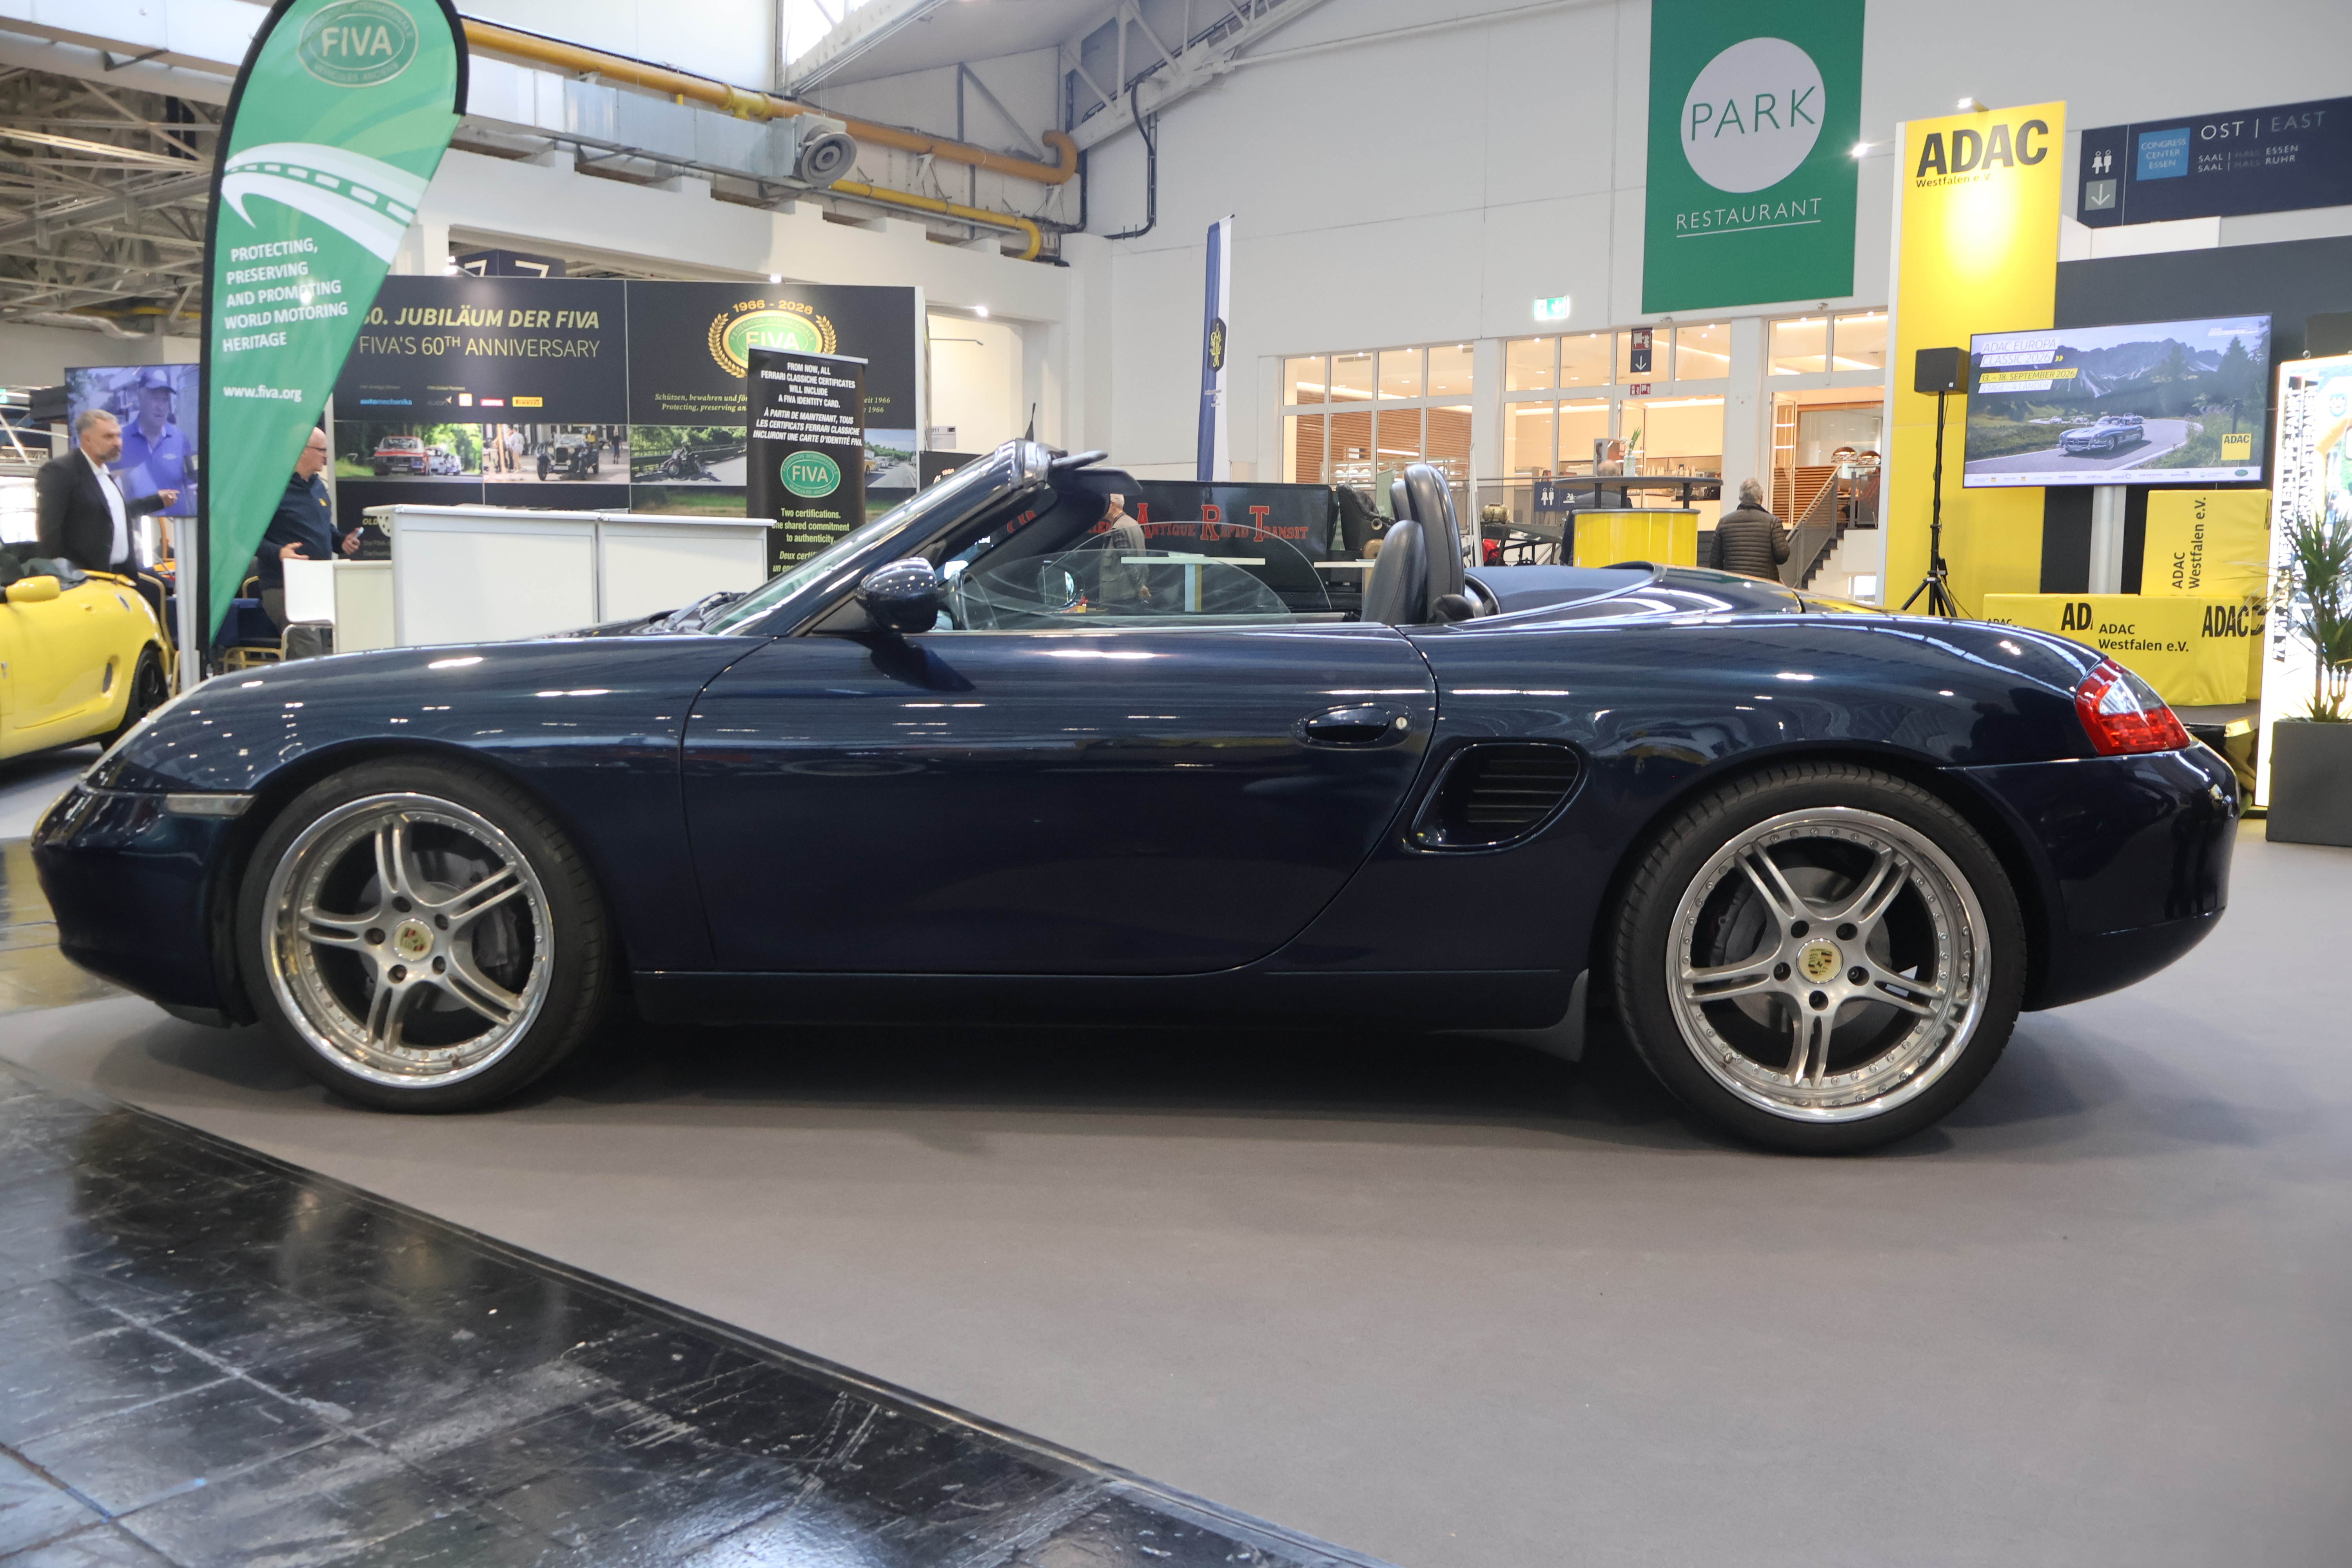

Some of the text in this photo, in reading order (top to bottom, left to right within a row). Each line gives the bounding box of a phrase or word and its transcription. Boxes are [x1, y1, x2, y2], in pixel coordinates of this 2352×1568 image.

[322, 25, 392, 57] FIVA
[1691, 85, 1816, 142] PARK
[2201, 121, 2244, 140] OST
[2271, 111, 2326, 132] EAST
[1916, 119, 2049, 178] ADAC
[2141, 138, 2186, 150] CONGRESS
[2146, 149, 2180, 159] CENTER
[2198, 153, 2223, 162] SAAL
[2266, 145, 2298, 155] ESSEN
[2149, 159, 2176, 169] ESSEN
[2198, 163, 2223, 172] SAAL
[2265, 155, 2296, 165] RUHR
[1916, 173, 1993, 188] Westfalen e.V.
[1677, 198, 1822, 230] RESTAURANT
[230, 238, 318, 262] PROTECTING,
[226, 261, 309, 285] PRESERVING
[226, 279, 341, 308] AND PROMOTING
[224, 301, 348, 329] WORLD MOTORING
[732, 299, 765, 312] 1966
[778, 300, 814, 315] 2026
[394, 305, 503, 327] JUBILÄUM
[508, 310, 551, 328] DER
[555, 310, 599, 328] FIVA
[222, 332, 287, 352] HERITAGE
[359, 336, 417, 355] FIVA'S
[465, 338, 600, 358] ANNIVERSARY
[746, 331, 800, 350] FIVA
[1983, 339, 2056, 352] ADAC EUROPA
[1983, 352, 2051, 365] CLASSIC 2026
[787, 362, 831, 375] FROM NOW, ALL
[2010, 371, 2055, 380] SEPTEMBER
[761, 370, 856, 389] FERRARI CLASSICHE CERTIFICATES
[2019, 381, 2049, 390] LÄNDER
[223, 384, 302, 403] www.fiva.org
[655, 393, 687, 401] Schützen,
[789, 384, 828, 396] WILL INCLUDE
[661, 403, 699, 412] Protecting,
[700, 404, 736, 412] preserving
[778, 394, 840, 408] A FIVA IDENTITY CARD.
[764, 407, 854, 425] À PARTIR DE MAINTENANT, TOUS
[756, 419, 860, 436] LES CERTIFICATS FERRARI CLASSICHE
[753, 430, 862, 446] INCLURONT UNE CARTE D'IDENTITÉ FIVA.
[2224, 435, 2250, 444] ADAC
[792, 465, 829, 483] FIVA
[781, 508, 841, 519] Two certifications.
[785, 521, 807, 530] shared
[808, 522, 850, 531] commitment
[1200, 504, 1249, 541] RAPID
[1249, 505, 1308, 542] TRANSIT
[786, 534, 836, 544] to authenticity.
[2188, 497, 2206, 589] Westfalen e.V.
[779, 551, 795, 560] Deux
[2172, 552, 2185, 589] ADAC
[2061, 603, 2093, 631] AD
[2201, 606, 2249, 637] ADAC
[2098, 624, 2136, 635] ADAC
[2098, 639, 2189, 652] Westfalen e.V.
[2273, 639, 2286, 659] 76.
